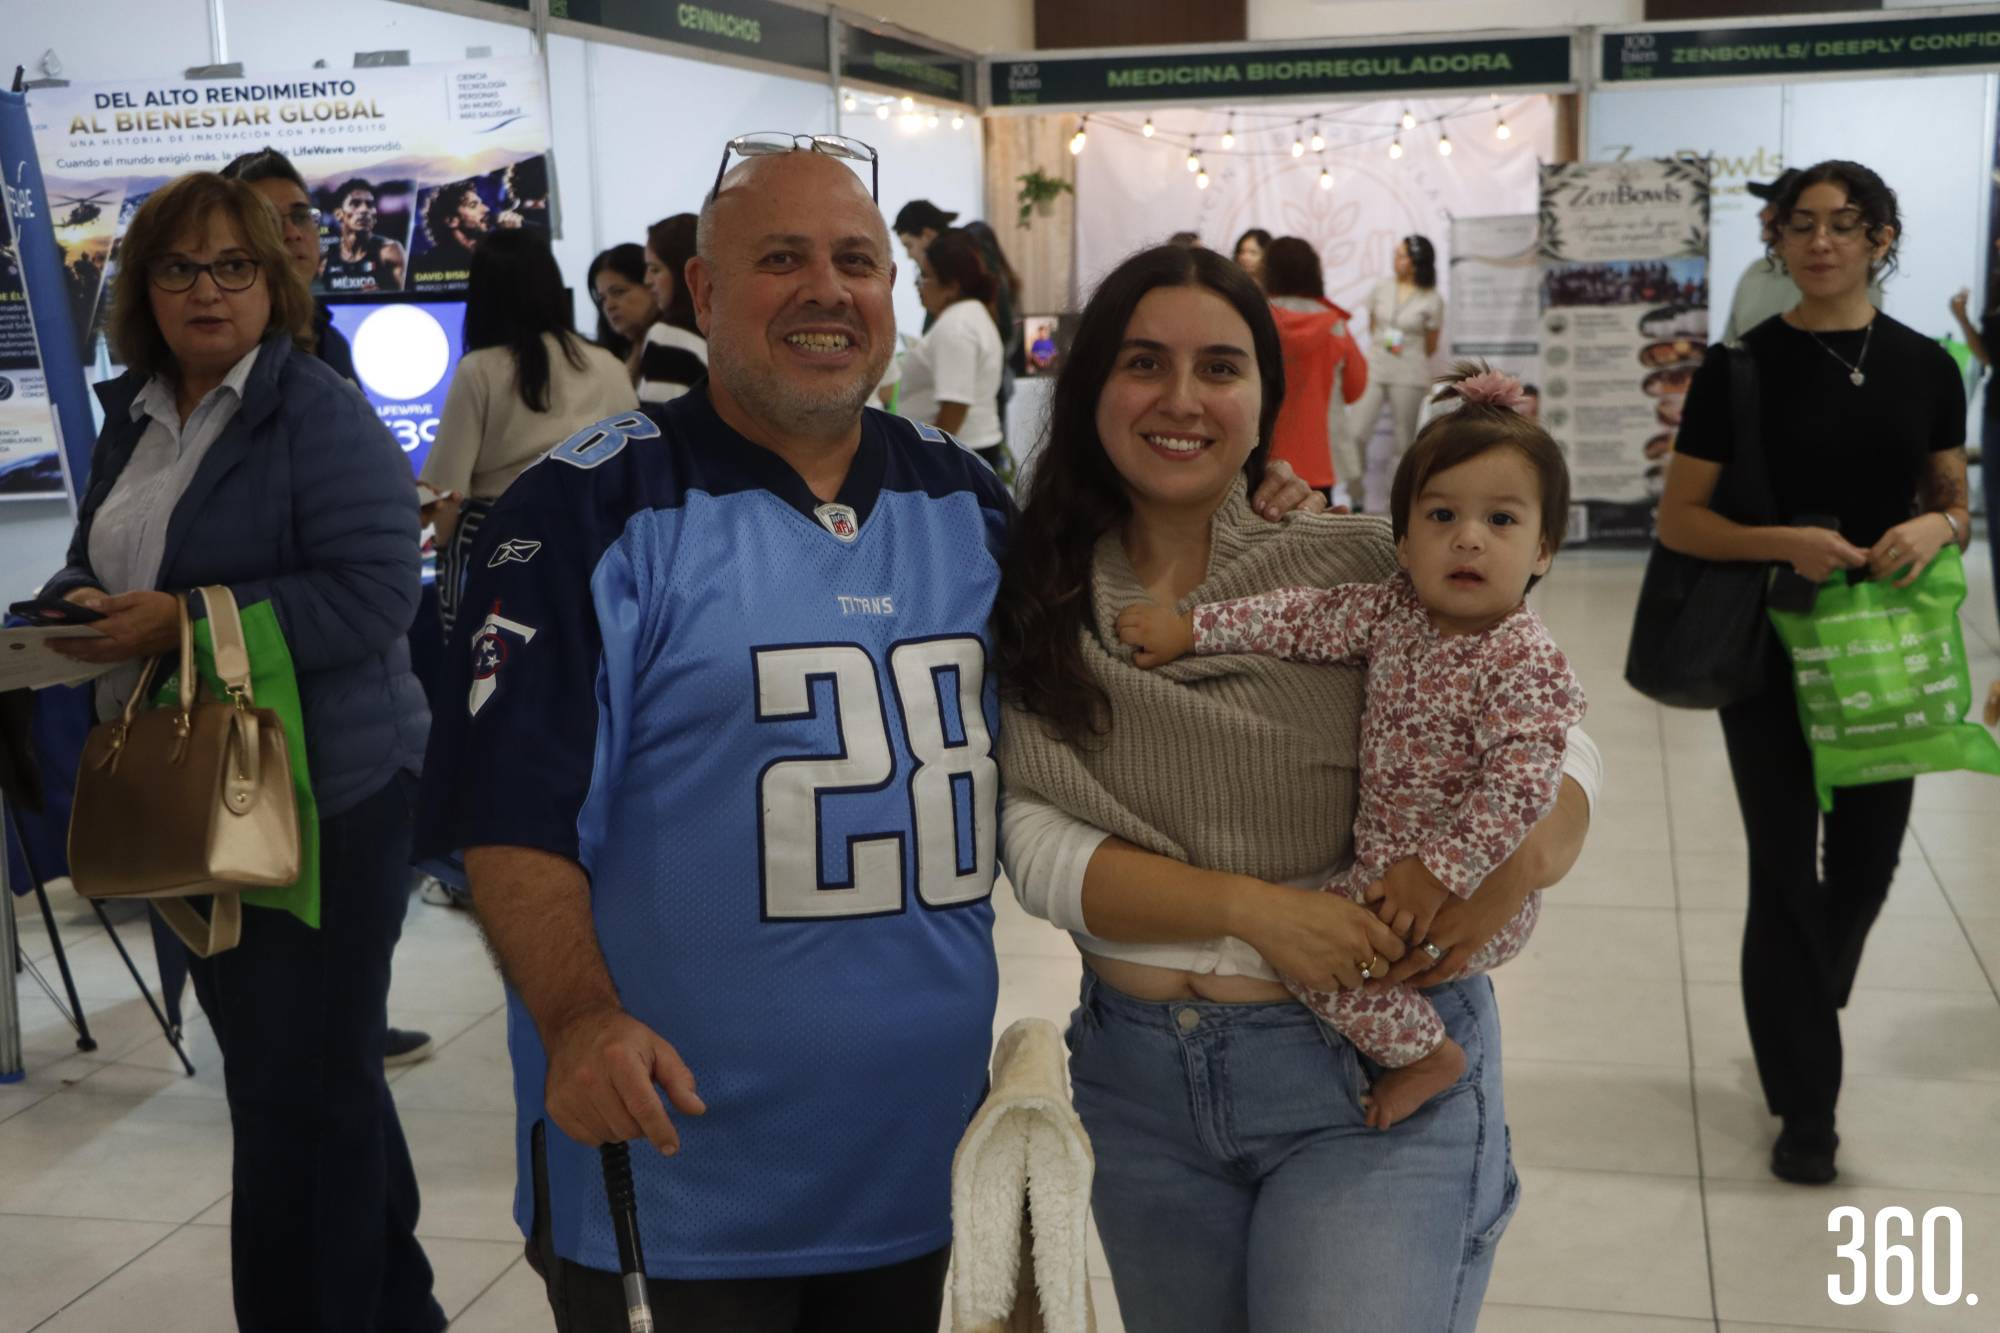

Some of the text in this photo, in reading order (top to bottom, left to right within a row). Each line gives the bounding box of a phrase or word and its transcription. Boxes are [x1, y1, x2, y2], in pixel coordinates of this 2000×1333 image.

[677, 3, 761, 43] CEVINACHOS
[1672, 42, 1809, 63] ZENBOWLS/
[1814, 37, 1905, 57] DEEPLY
[1107, 53, 1513, 87] MEDICINA BIORREGULADORA
[94, 80, 356, 109] DEL ALTO RENDIMIENTO
[70, 98, 385, 134] AL BIENESTAR GLOBAL
[70, 139, 96, 148] UNA
[103, 136, 162, 146] HISTORIA
[169, 135, 184, 143] DE
[278, 129, 303, 137] CON
[56, 158, 100, 169] Cuando
[103, 156, 113, 166] el
[116, 153, 154, 166] mundo
[293, 144, 344, 157] LifeWave
[1569, 183, 1682, 207] ZenBowls
[414, 272, 444, 282] DAVID
[833, 520, 856, 535] NFL
[837, 596, 895, 617] TITANS
[750, 633, 998, 923] 28
